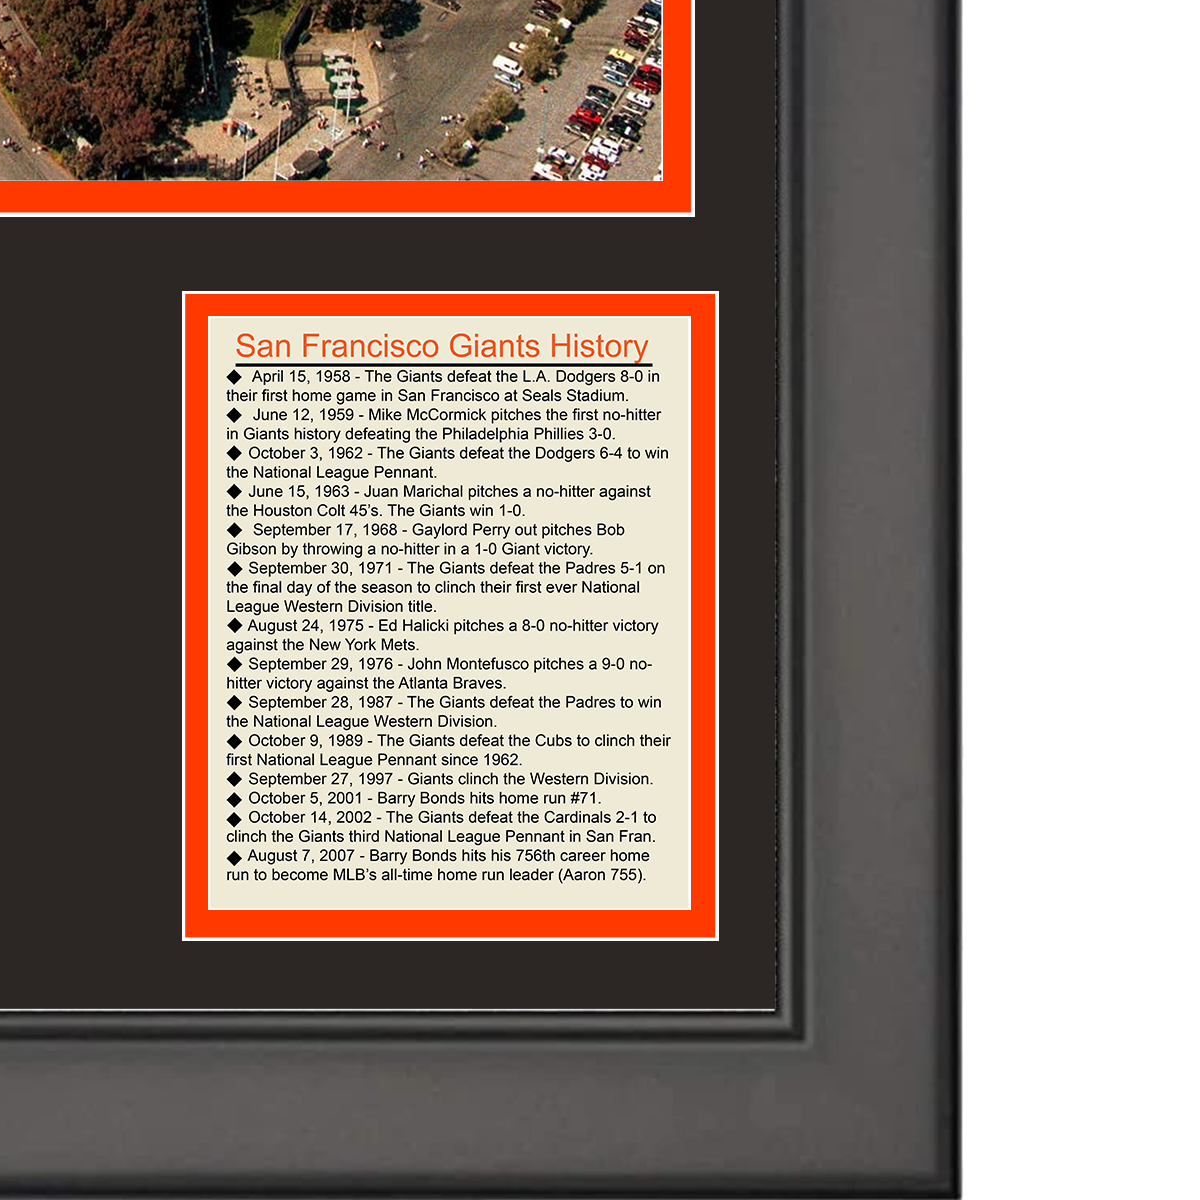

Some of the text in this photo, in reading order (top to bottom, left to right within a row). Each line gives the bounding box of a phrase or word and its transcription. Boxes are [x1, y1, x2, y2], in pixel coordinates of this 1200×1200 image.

[235, 332, 649, 365] San Francisco Giants History
[225, 388, 629, 406] their first home game in San Francisco at Seals Stadium.
[252, 407, 288, 422] June
[292, 407, 314, 424] 12,
[319, 407, 355, 422] 1959
[368, 407, 403, 422] Mike
[406, 407, 487, 422] McCormick
[491, 407, 542, 425] pitches
[545, 407, 569, 422] the
[571, 407, 599, 422] first
[602, 407, 663, 422] no-hitter
[226, 426, 616, 444] in Giants history defeating the Philadelphia Phillies 3-0.
[225, 465, 437, 482] the National League Pennant.
[225, 503, 249, 517] the
[253, 503, 313, 517] Houston
[316, 503, 346, 517] Colt
[386, 503, 415, 517] The
[419, 503, 466, 517] Giants
[469, 503, 494, 517] win
[499, 503, 526, 517] 1-0.
[253, 522, 332, 540] September
[336, 522, 358, 539] 17,
[362, 522, 398, 537] 1968
[411, 522, 468, 540] Gaylord
[472, 522, 511, 540] Perry
[514, 523, 538, 537] out
[541, 522, 593, 540] pitches
[596, 522, 626, 537] Bob
[226, 541, 594, 559] Gibson by throwing a no-hitter in a 1-0 Giant victory.
[225, 580, 640, 597] the final day of the season to clinch their first ever National
[226, 599, 437, 616] League Western Division title.
[226, 637, 420, 655] against the New York Mets.
[248, 656, 328, 674] September
[330, 656, 353, 673] 29,
[358, 656, 394, 671] 1976
[407, 657, 442, 671] John
[446, 656, 530, 671] Montefusco
[533, 656, 585, 674] pitches
[588, 659, 598, 671] a
[601, 656, 625, 671] 9-0
[629, 659, 653, 671] no-
[226, 676, 507, 693] hitter victory against the Atlanta Braves.
[225, 714, 497, 732] the National League Western Division.
[225, 752, 523, 770] first National League Pennant since 1962.
[248, 771, 328, 789] September
[330, 771, 353, 788] 27,
[358, 771, 394, 786] 1997
[407, 771, 454, 786] Giants
[457, 771, 499, 786] clinch
[502, 771, 526, 786] the
[529, 771, 589, 786] Western
[593, 771, 654, 786] Division.
[226, 829, 656, 846] clinch the Giants third National League Pennant in San Fran.
[226, 870, 250, 882] run
[253, 868, 268, 882] to
[271, 867, 329, 882] become
[381, 867, 433, 882] all-time
[437, 867, 478, 882] home
[481, 870, 505, 882] run
[509, 867, 555, 882] leader
[558, 867, 606, 885] (Aaron
[610, 867, 647, 885] 755).
